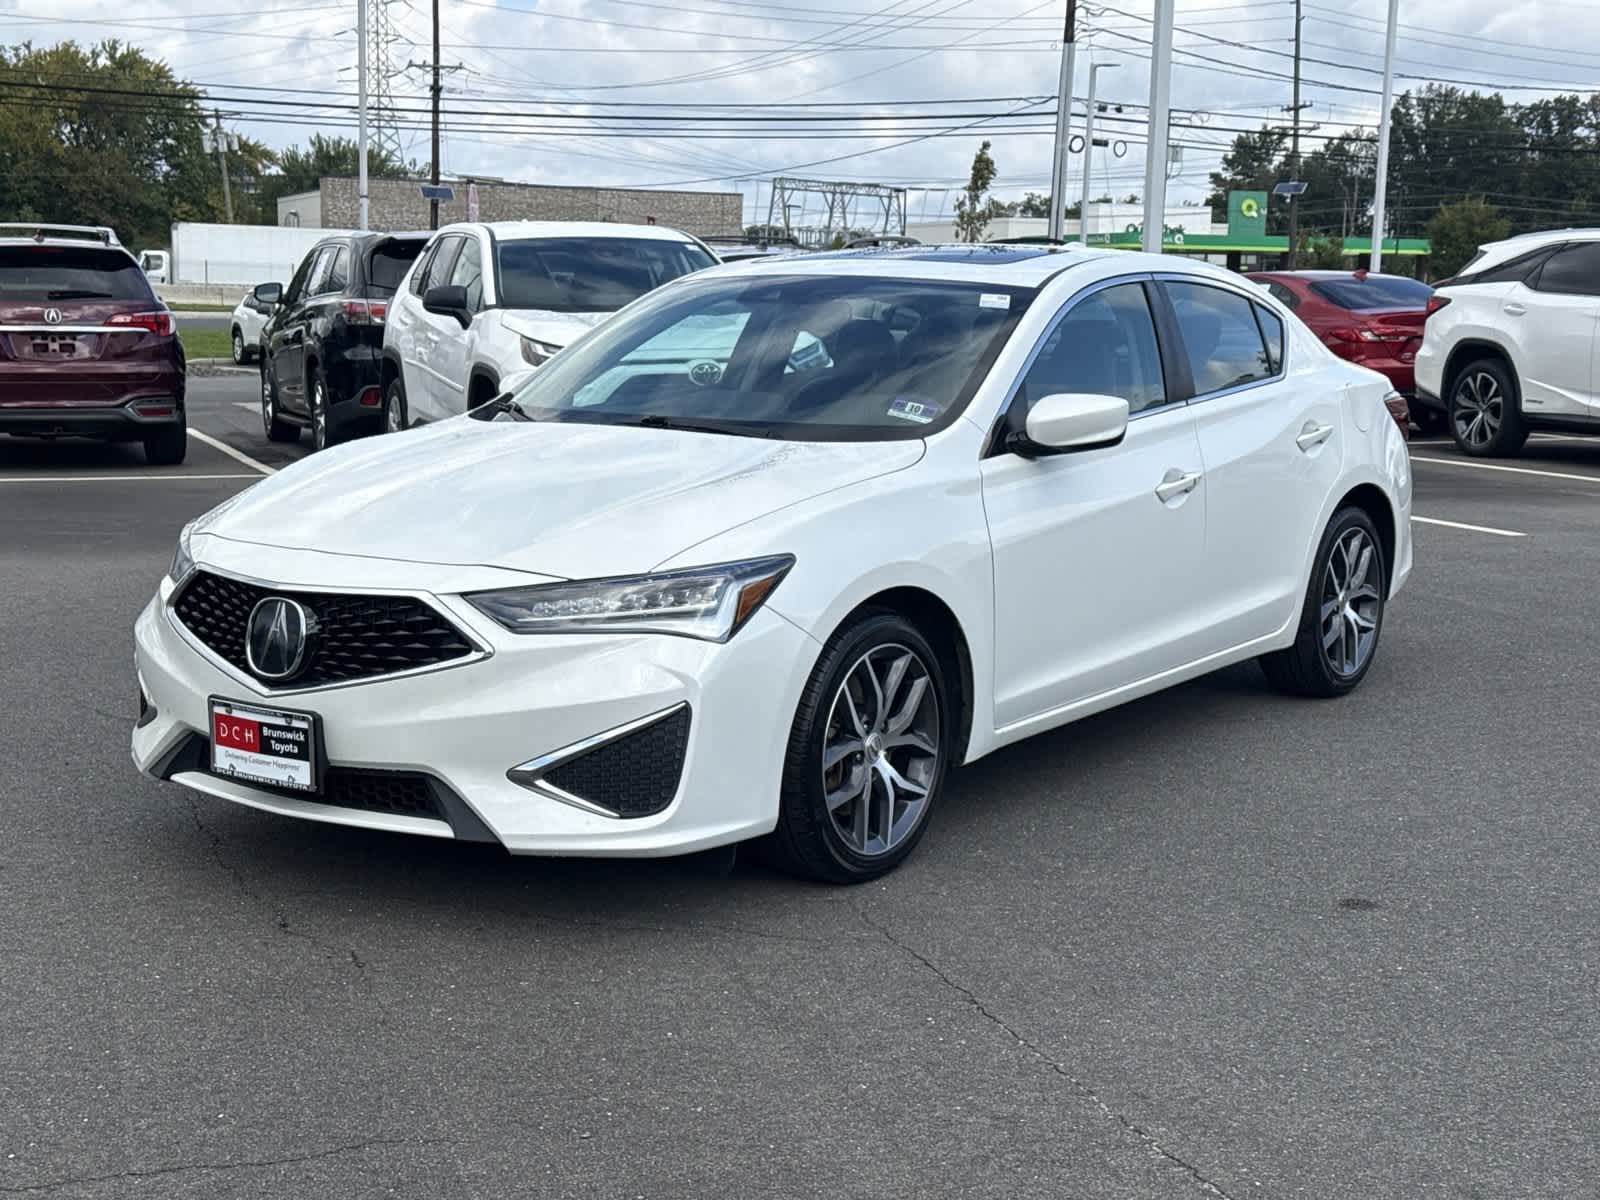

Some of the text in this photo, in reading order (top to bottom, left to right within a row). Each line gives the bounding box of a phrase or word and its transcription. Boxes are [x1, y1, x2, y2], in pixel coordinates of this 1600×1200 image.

[1241, 198, 1258, 218] Q
[262, 726, 305, 741] Brunswick
[270, 740, 298, 754] Toyota
